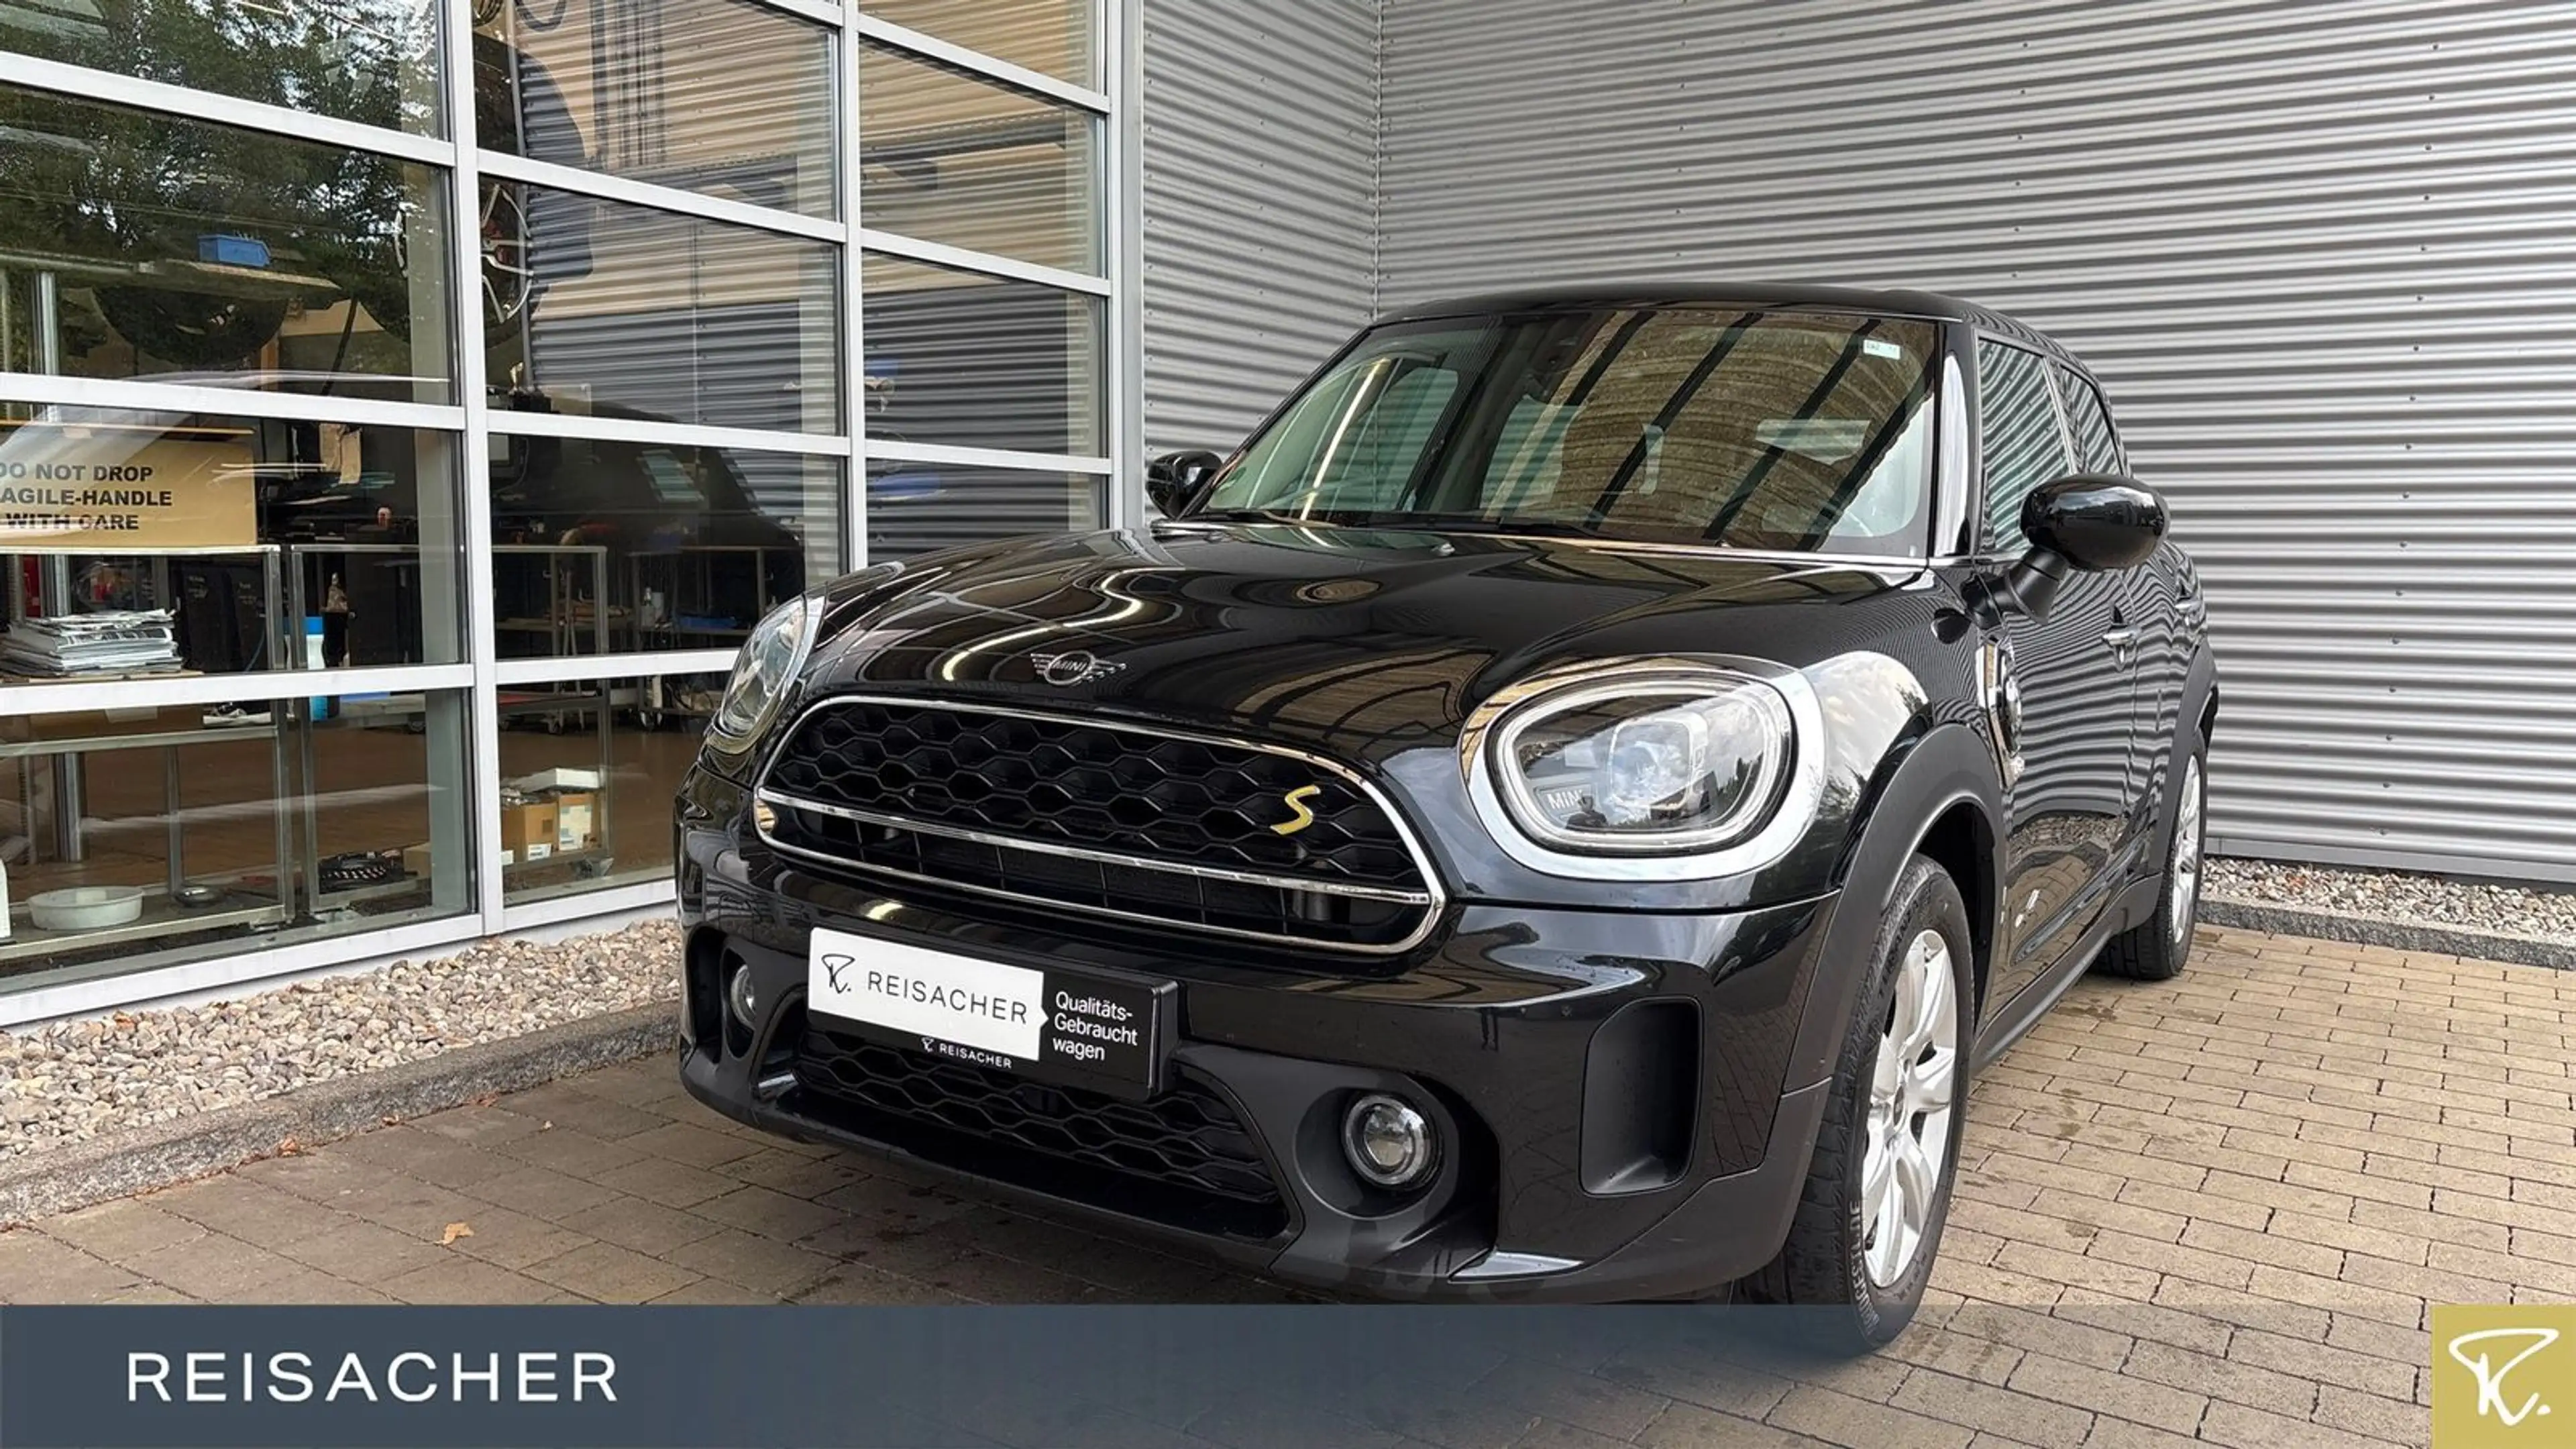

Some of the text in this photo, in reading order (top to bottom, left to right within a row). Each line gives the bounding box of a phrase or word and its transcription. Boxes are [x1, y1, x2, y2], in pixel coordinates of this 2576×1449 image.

[36, 464, 85, 480] NOT
[93, 466, 153, 482] DROP
[6, 513, 139, 530] WITH CARE
[1052, 660, 1087, 671] MINI
[1270, 784, 1321, 835] S
[868, 971, 1027, 1024] REISACHER
[1055, 991, 1133, 1021] Qualitäts-
[1055, 1012, 1138, 1046] Gebraucht
[940, 1042, 1012, 1069] REISACHER
[1053, 1037, 1106, 1061] wagen
